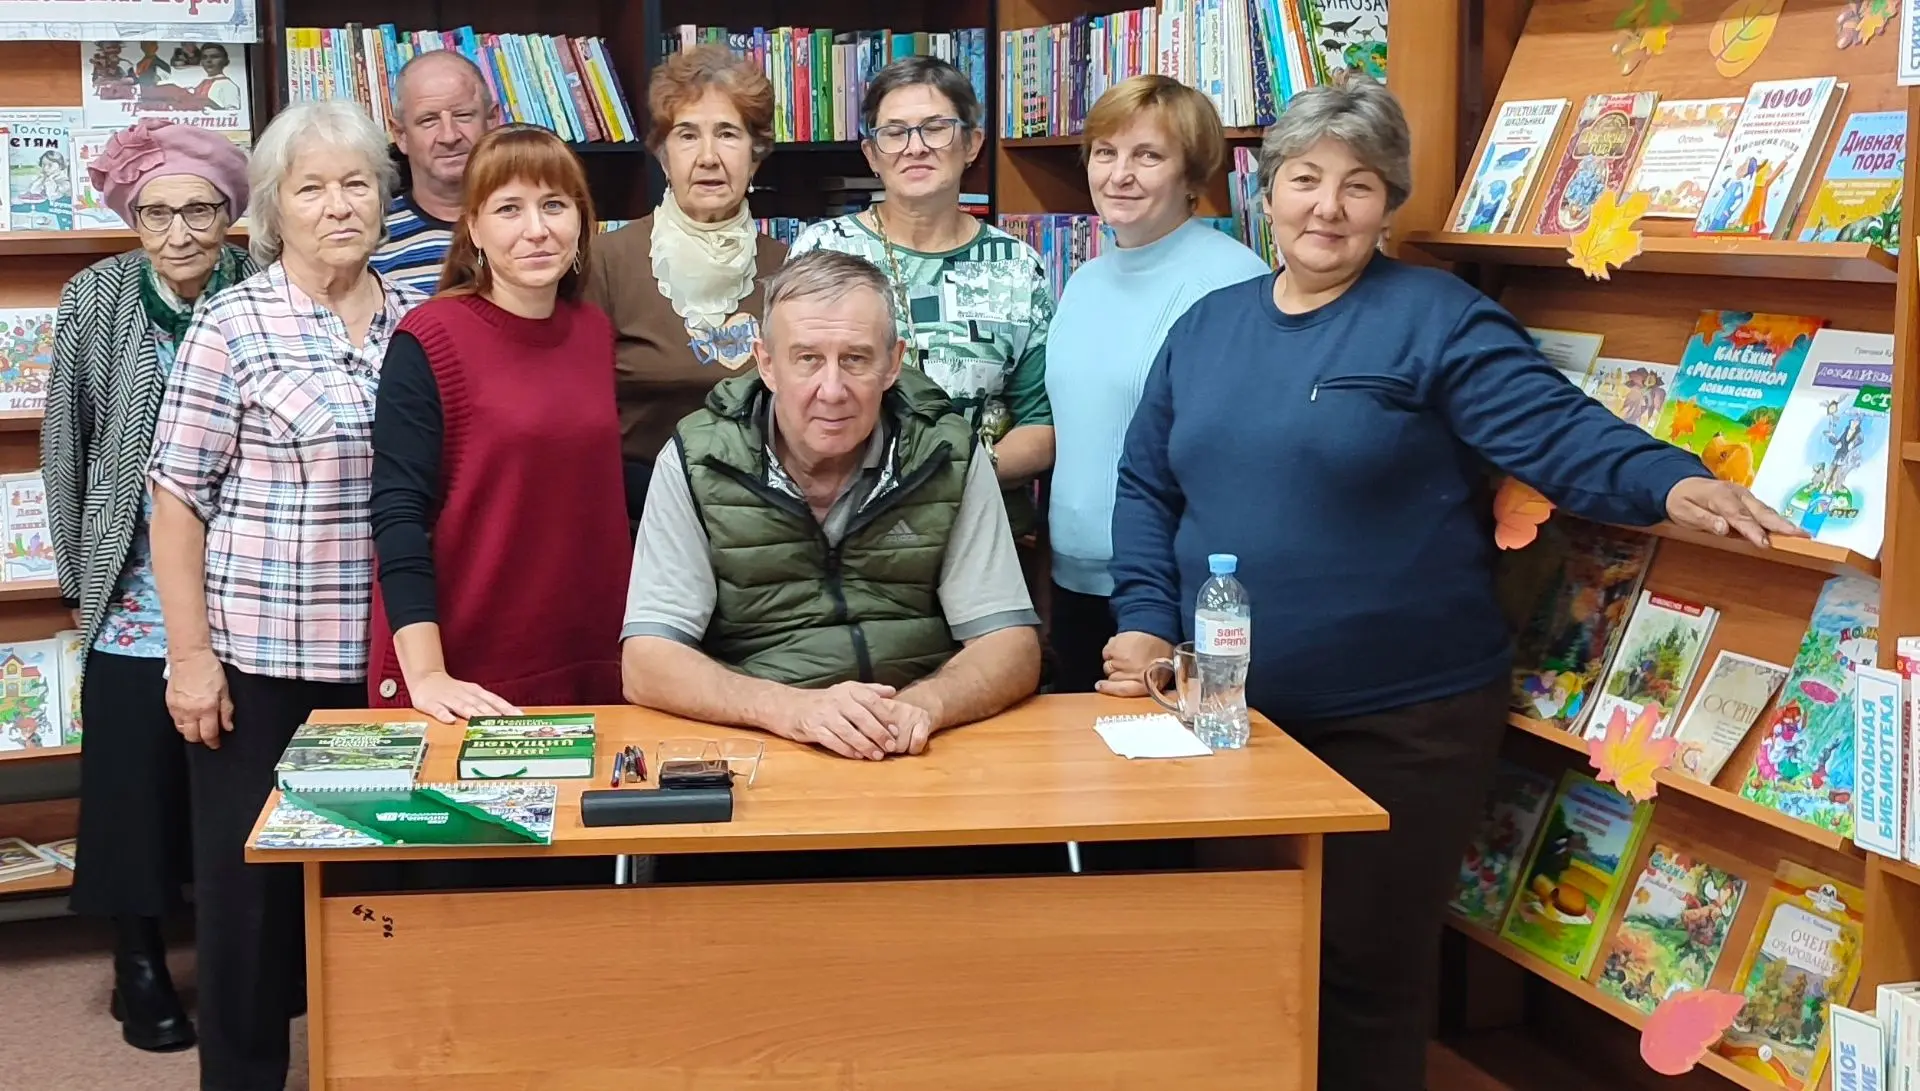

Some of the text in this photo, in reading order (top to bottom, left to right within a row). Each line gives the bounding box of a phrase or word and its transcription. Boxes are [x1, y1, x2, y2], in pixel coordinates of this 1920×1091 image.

[1314, 0, 1388, 12] ДИНОЗА
[1171, 17, 1180, 80] АЛИСТАМ
[1759, 87, 1814, 110] 1000
[9, 137, 59, 149] етям
[1840, 129, 1905, 157] Дивная
[1851, 152, 1897, 174] пора
[1817, 365, 1893, 384] ДОЖДЛИВЫ
[1861, 392, 1893, 409] ОСТ
[1860, 698, 1876, 823] ШКОЛЬНАЯ
[1878, 694, 1895, 840] БИБЛИОТЕКА
